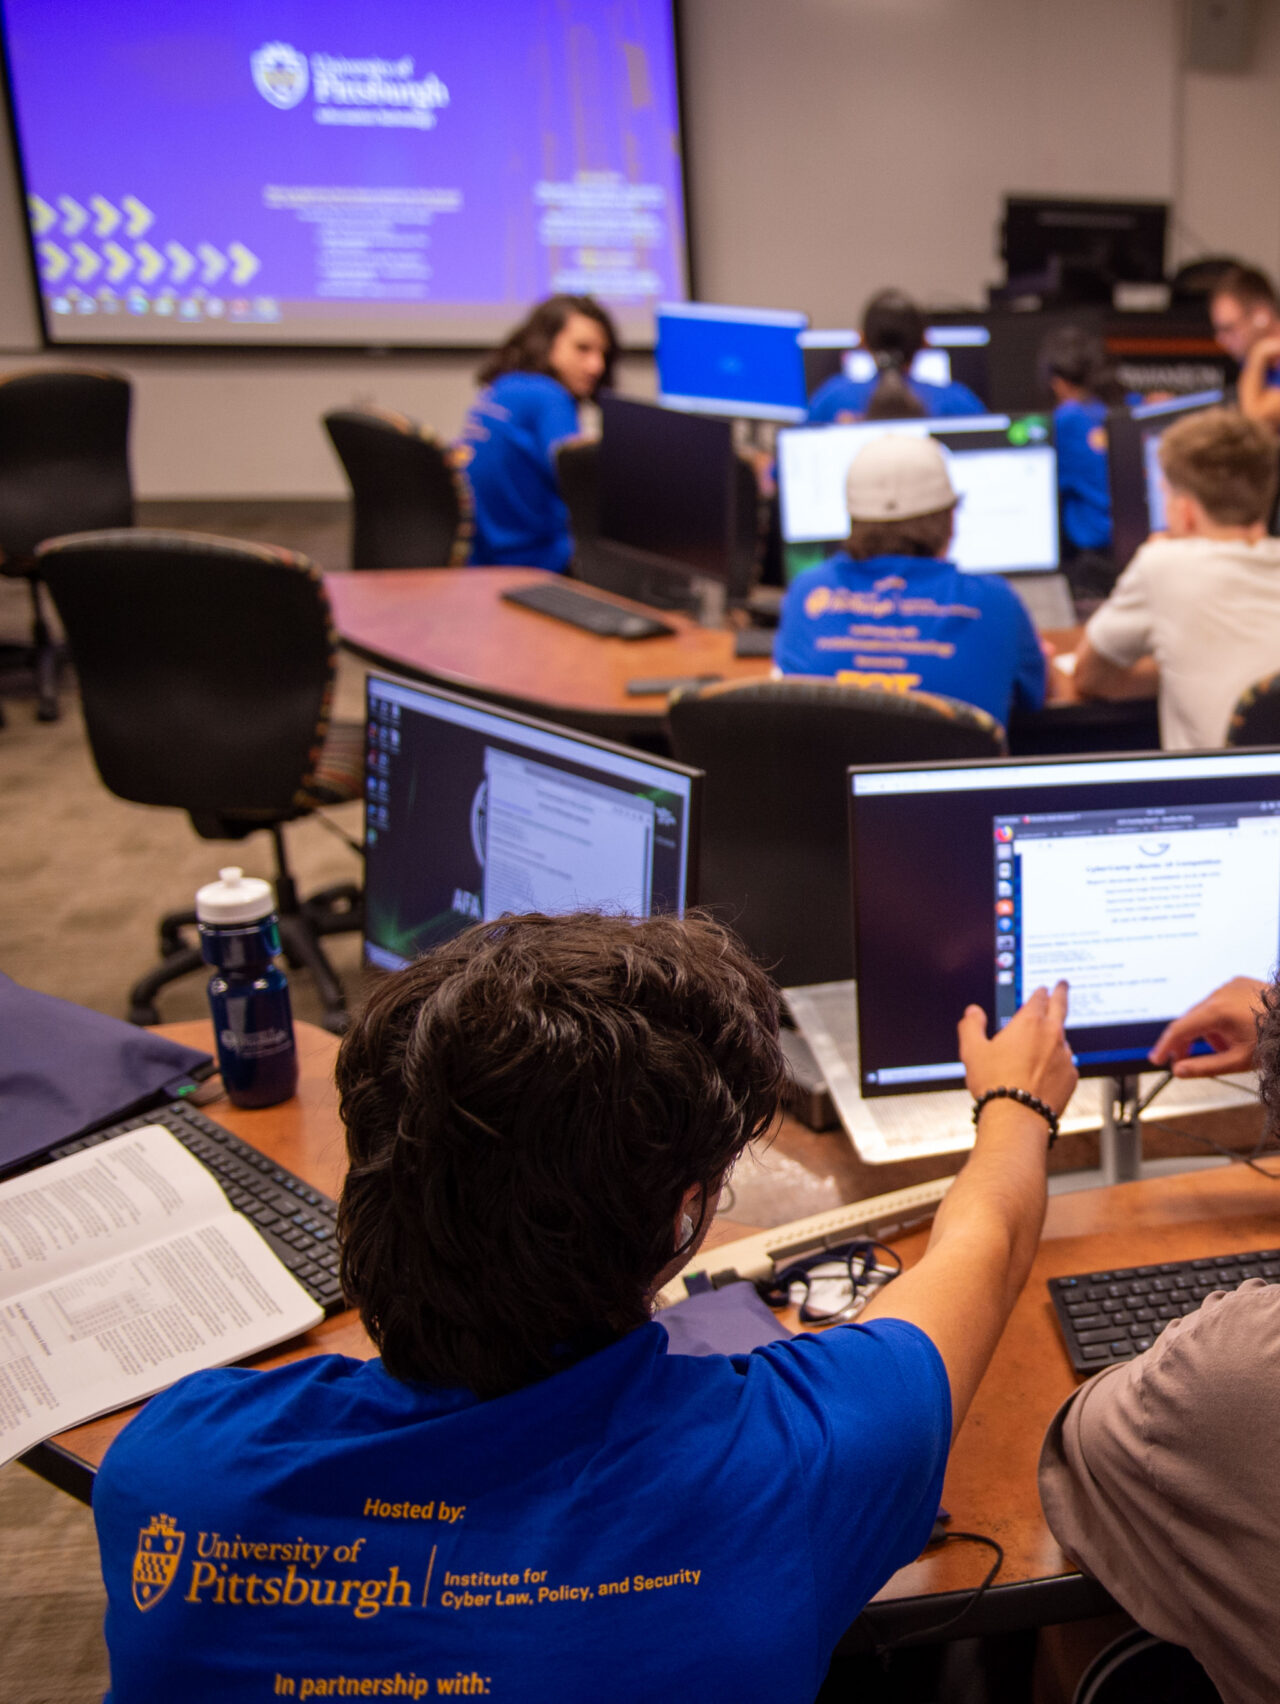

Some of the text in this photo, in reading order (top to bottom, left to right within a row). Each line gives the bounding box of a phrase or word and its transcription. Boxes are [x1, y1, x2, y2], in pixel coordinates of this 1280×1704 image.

[363, 1498, 466, 1524] Hosted by:
[196, 1532, 366, 1569] University of
[184, 1561, 411, 1619] Pittsburgh
[441, 1591, 491, 1610] Cyber
[537, 1585, 594, 1602] Policy,
[598, 1577, 629, 1596] and
[633, 1568, 701, 1591] Security
[444, 1568, 548, 1587] Institute for
[274, 1671, 491, 1701] In partnership with:
